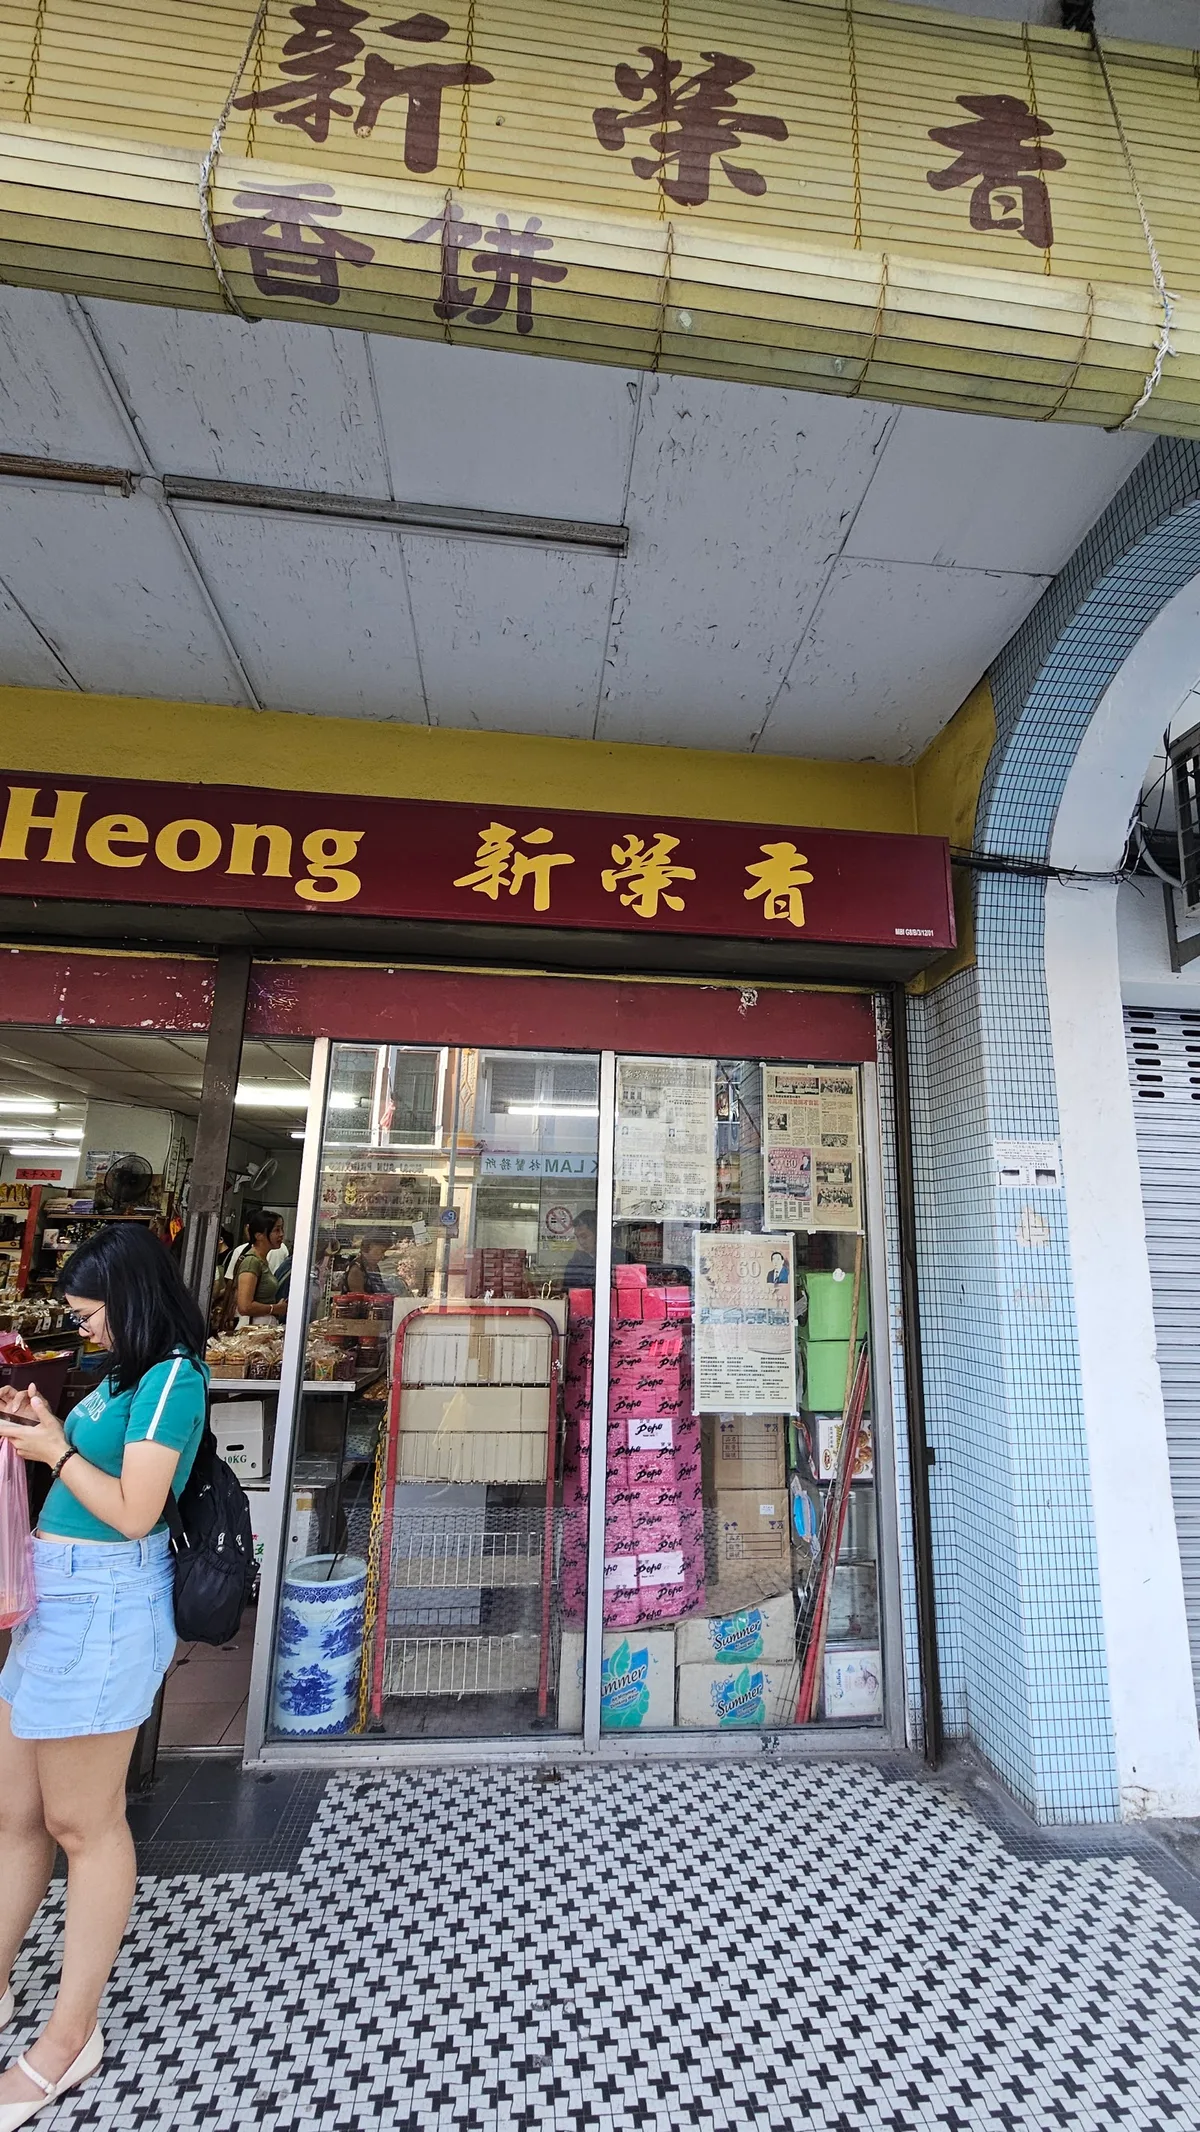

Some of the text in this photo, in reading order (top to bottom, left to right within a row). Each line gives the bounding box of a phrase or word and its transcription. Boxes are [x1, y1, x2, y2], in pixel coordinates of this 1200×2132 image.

[0, 786, 366, 903] Heong
[736, 1260, 762, 1279] 60
[715, 1620, 761, 1650] Summer
[602, 1666, 646, 1696] mmer
[717, 1684, 762, 1716] Summer
